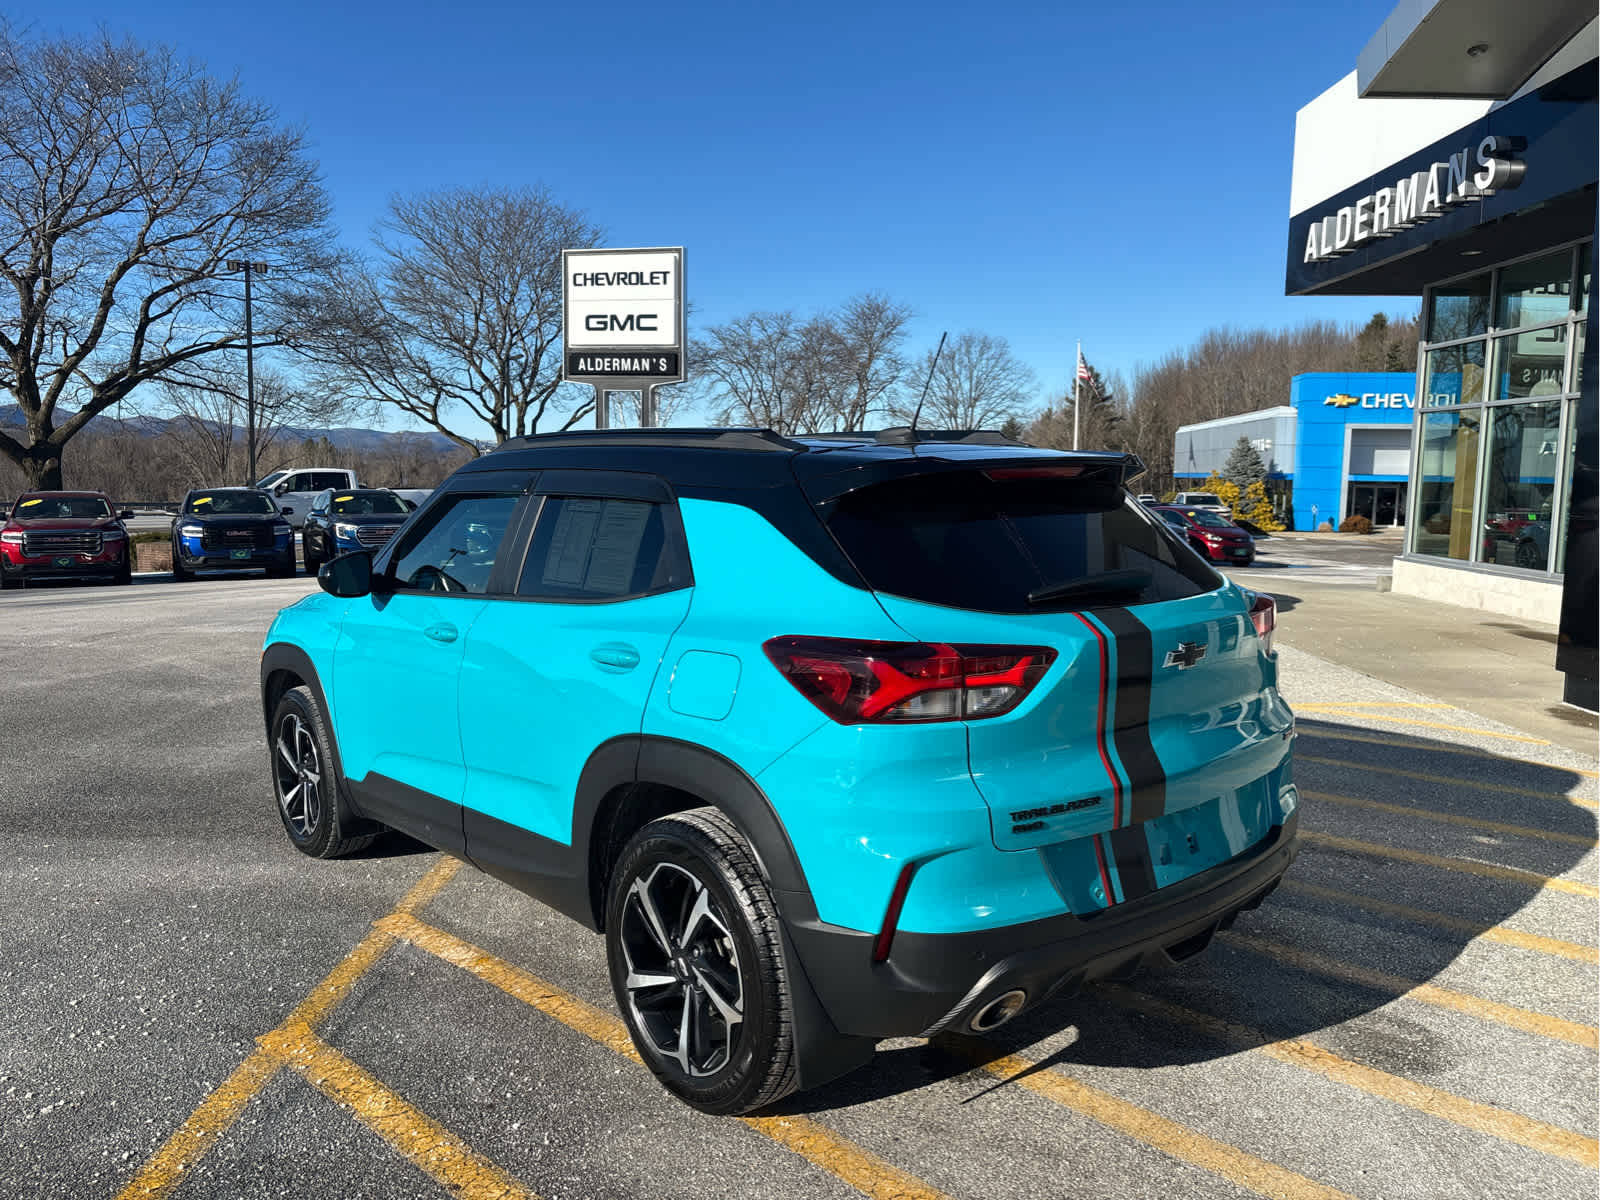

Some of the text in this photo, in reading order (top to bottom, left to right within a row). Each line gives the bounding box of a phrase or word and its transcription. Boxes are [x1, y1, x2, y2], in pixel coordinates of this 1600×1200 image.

[573, 271, 670, 286] CHEVROLET
[585, 314, 658, 332] GMC
[578, 358, 667, 372] ALDERMAN'S
